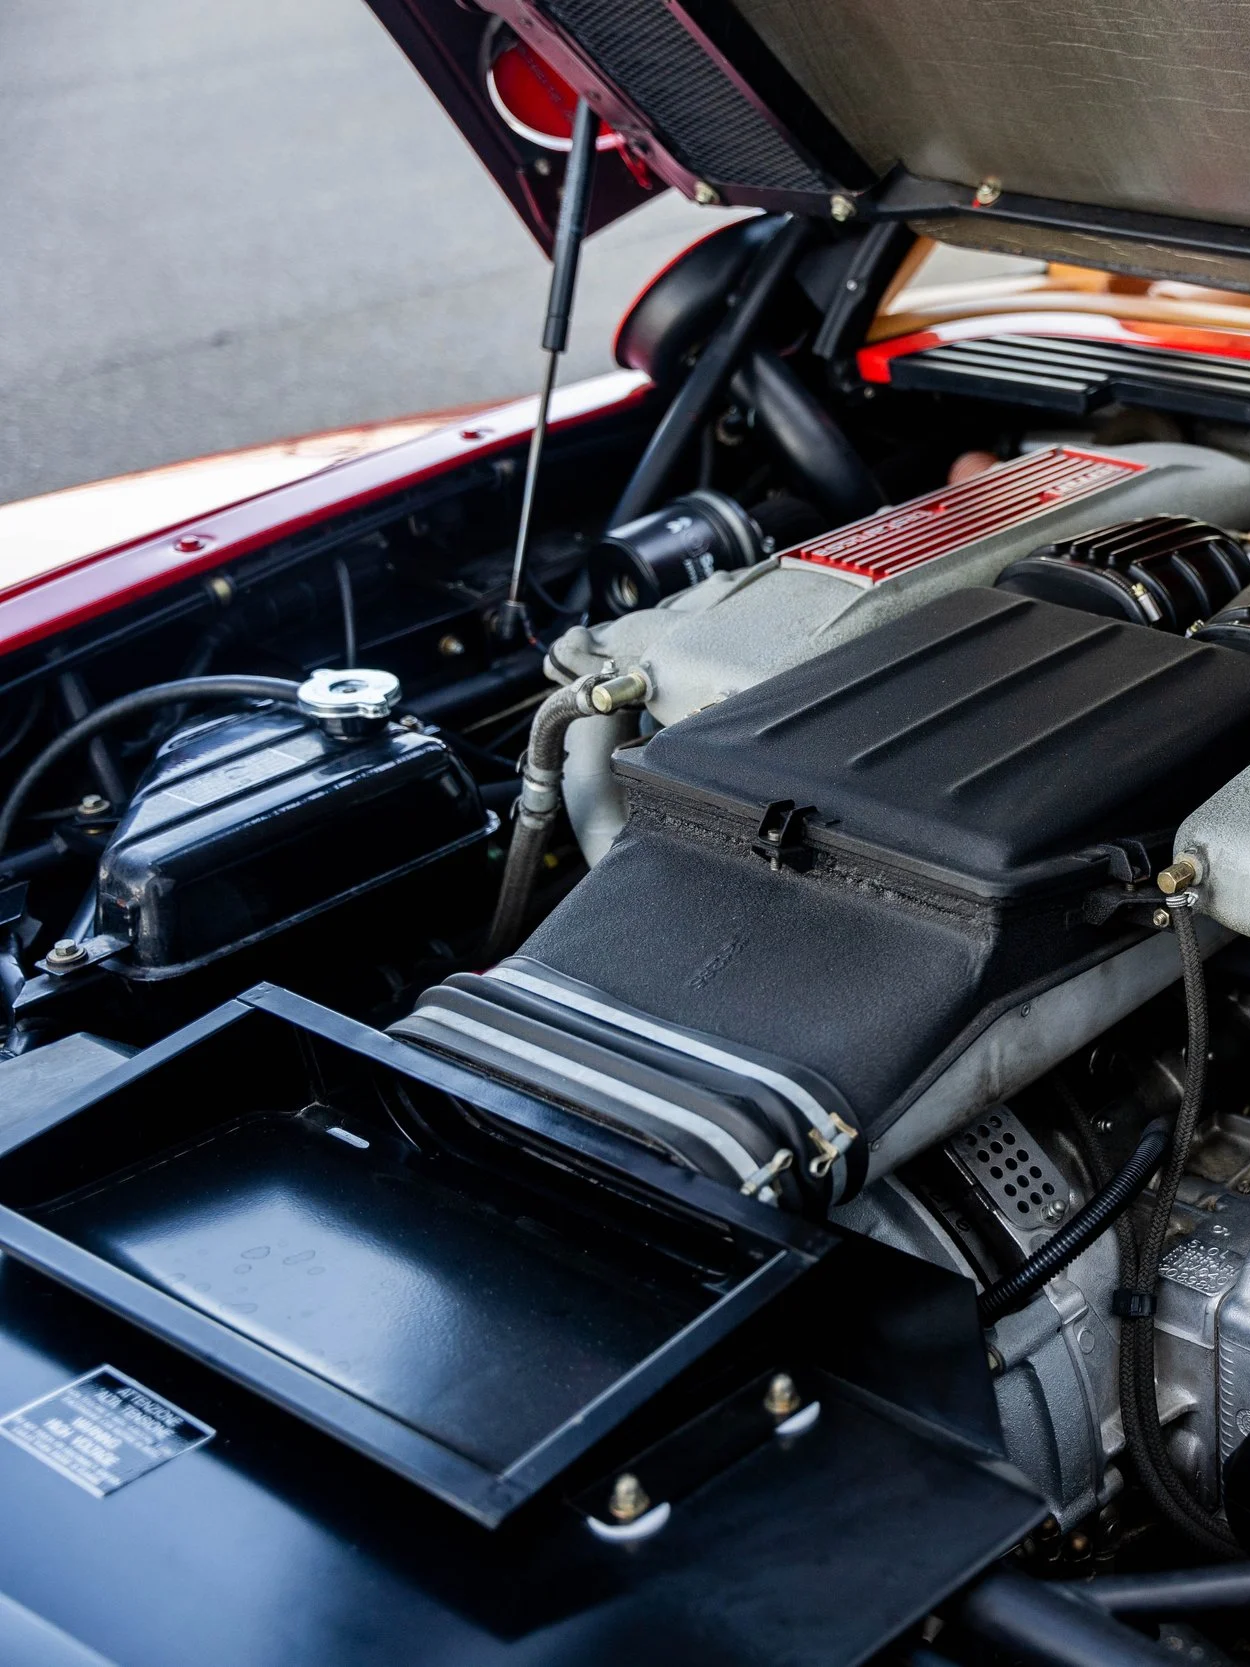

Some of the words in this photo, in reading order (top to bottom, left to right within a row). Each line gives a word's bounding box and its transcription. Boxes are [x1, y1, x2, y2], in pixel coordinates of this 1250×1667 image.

[95, 1388, 122, 1409] ALTA
[121, 1404, 175, 1440] TENSIONE
[117, 1388, 185, 1427] ATTENZIONE
